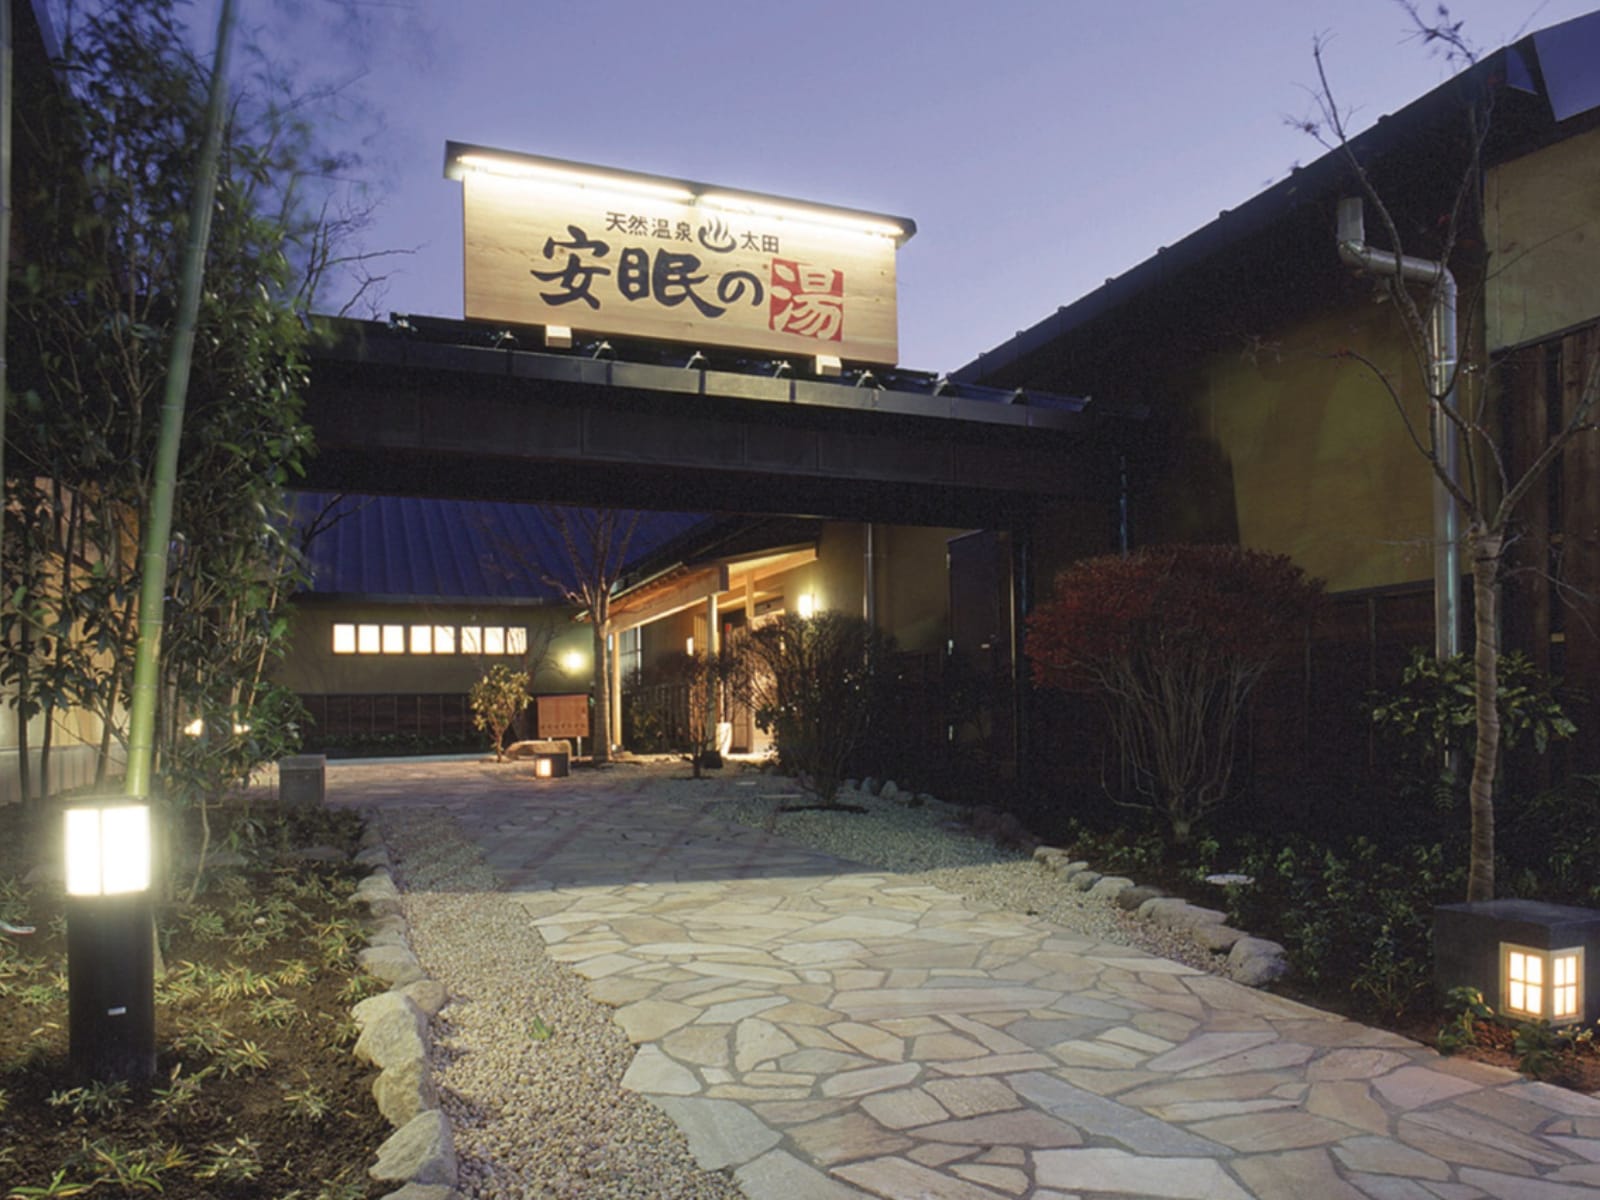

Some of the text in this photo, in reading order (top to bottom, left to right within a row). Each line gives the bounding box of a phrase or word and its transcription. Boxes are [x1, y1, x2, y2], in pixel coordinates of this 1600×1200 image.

[606, 211, 780, 254] 天然温泉 太田
[530, 225, 844, 342] 安眠の湯
